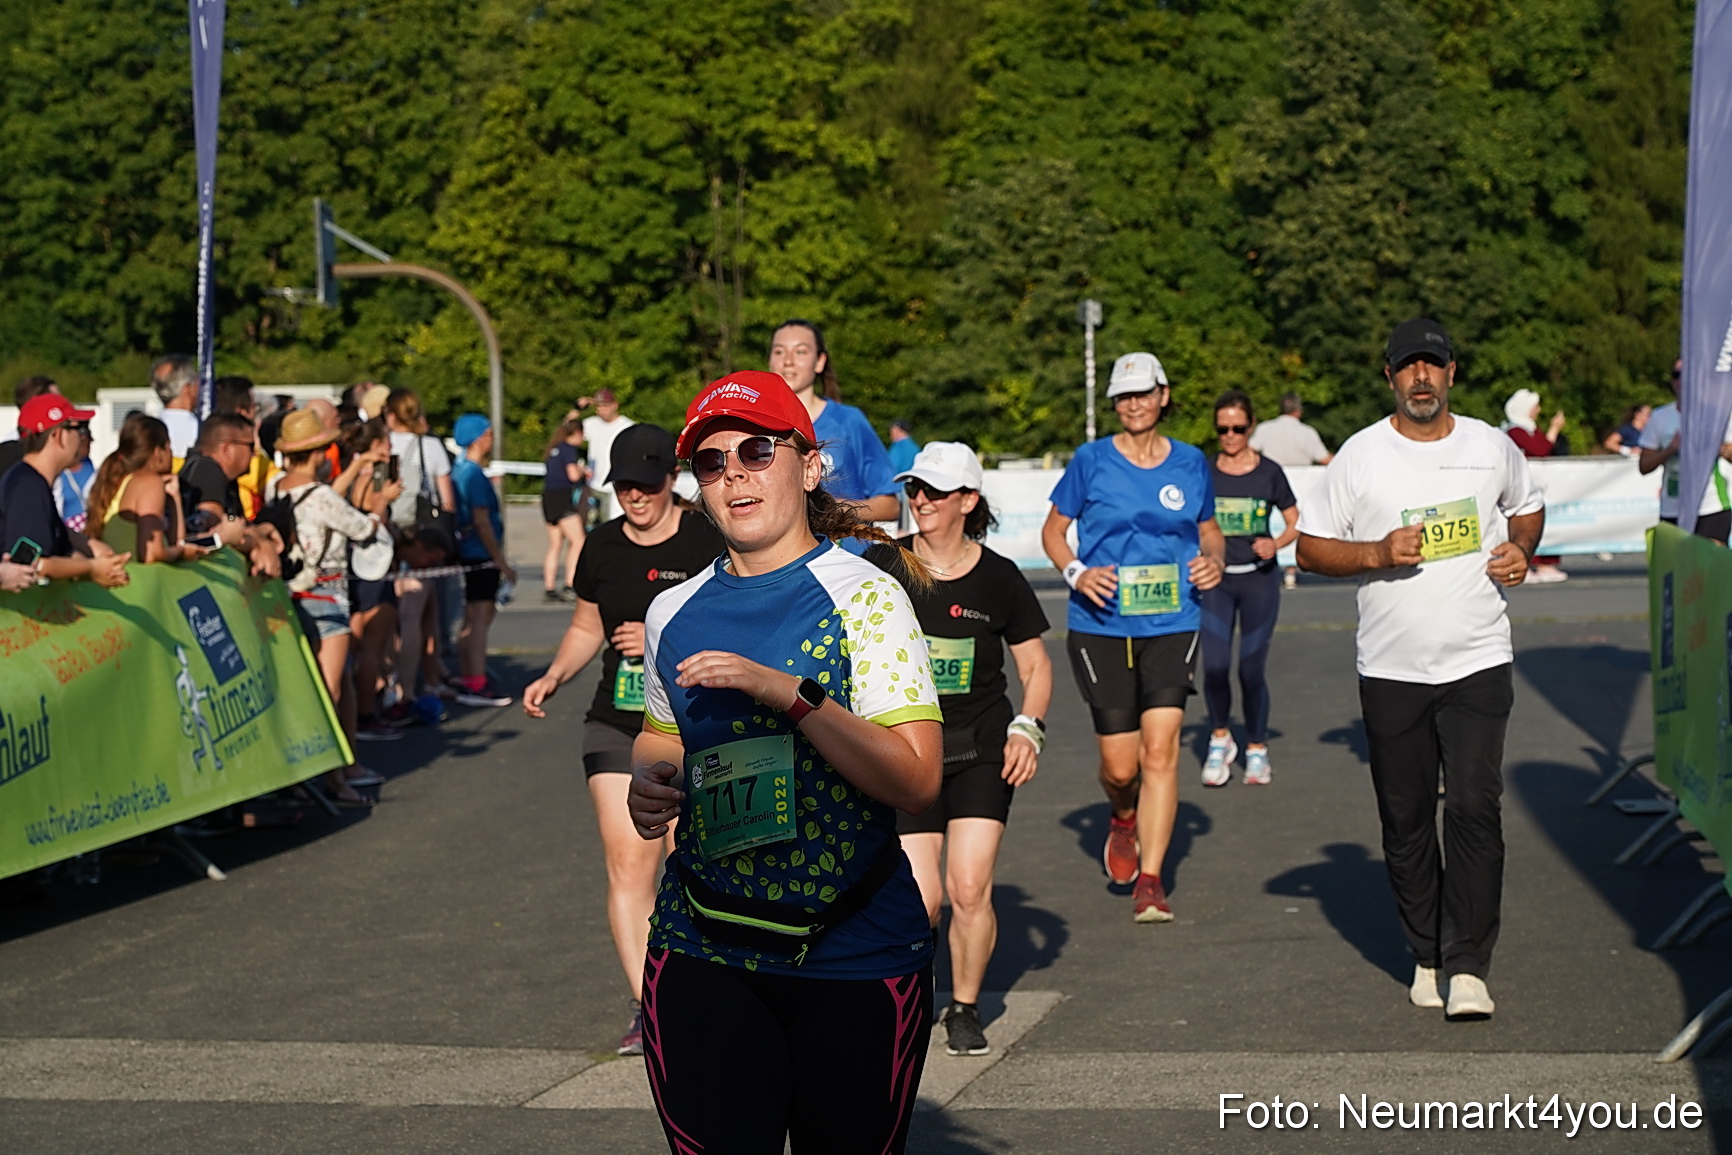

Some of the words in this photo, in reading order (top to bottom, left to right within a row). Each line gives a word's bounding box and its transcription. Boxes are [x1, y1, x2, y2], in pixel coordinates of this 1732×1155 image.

[709, 382, 741, 401] AVIA
[720, 391, 757, 404] racing
[1420, 518, 1470, 545] 1975
[1132, 582, 1172, 598] 1746
[929, 658, 960, 677] 36
[704, 761, 733, 780] Firmenlauf
[714, 769, 734, 780] neumarkt
[705, 775, 758, 821] 717
[774, 775, 788, 825] 2022
[743, 810, 776, 826] Carolin
